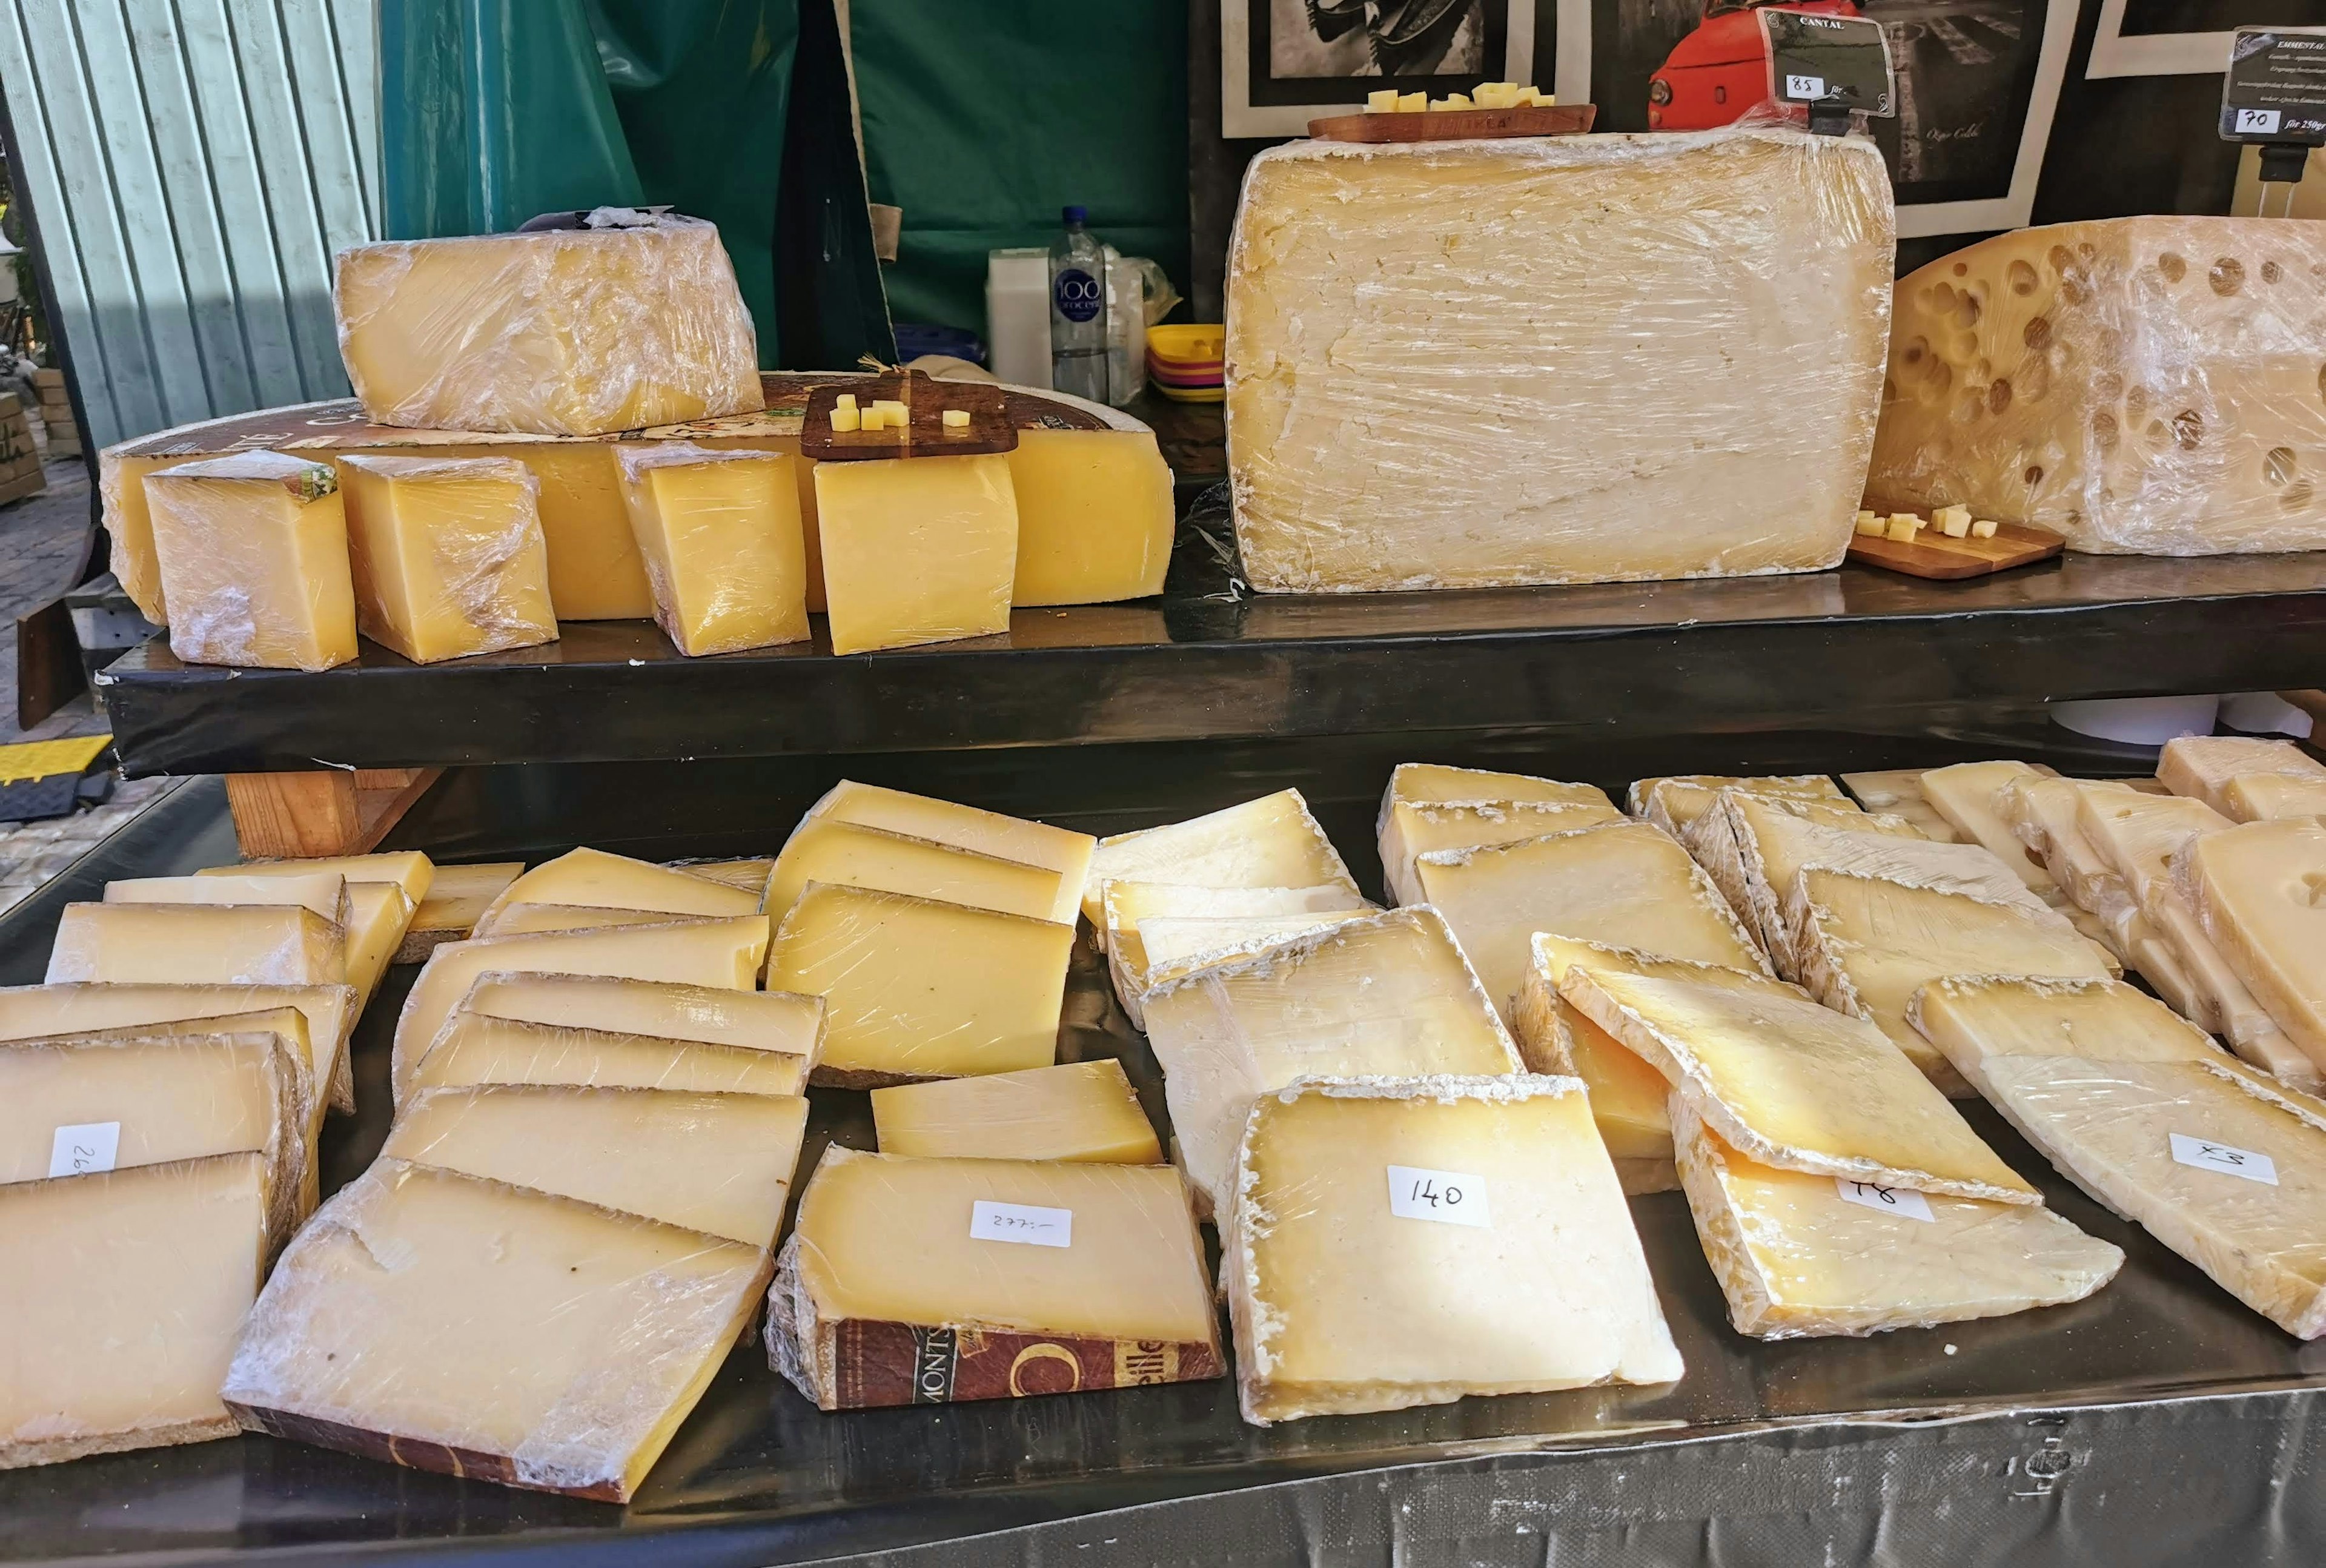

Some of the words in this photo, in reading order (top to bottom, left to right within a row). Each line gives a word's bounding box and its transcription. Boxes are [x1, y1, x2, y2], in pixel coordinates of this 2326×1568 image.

[1800, 18, 1844, 30] CANTAL
[1792, 77, 1812, 91] 85
[2245, 111, 2267, 127] 70
[1059, 280, 1101, 300] 100
[73, 1145, 96, 1174] 26
[1412, 1179, 1462, 1207] 140
